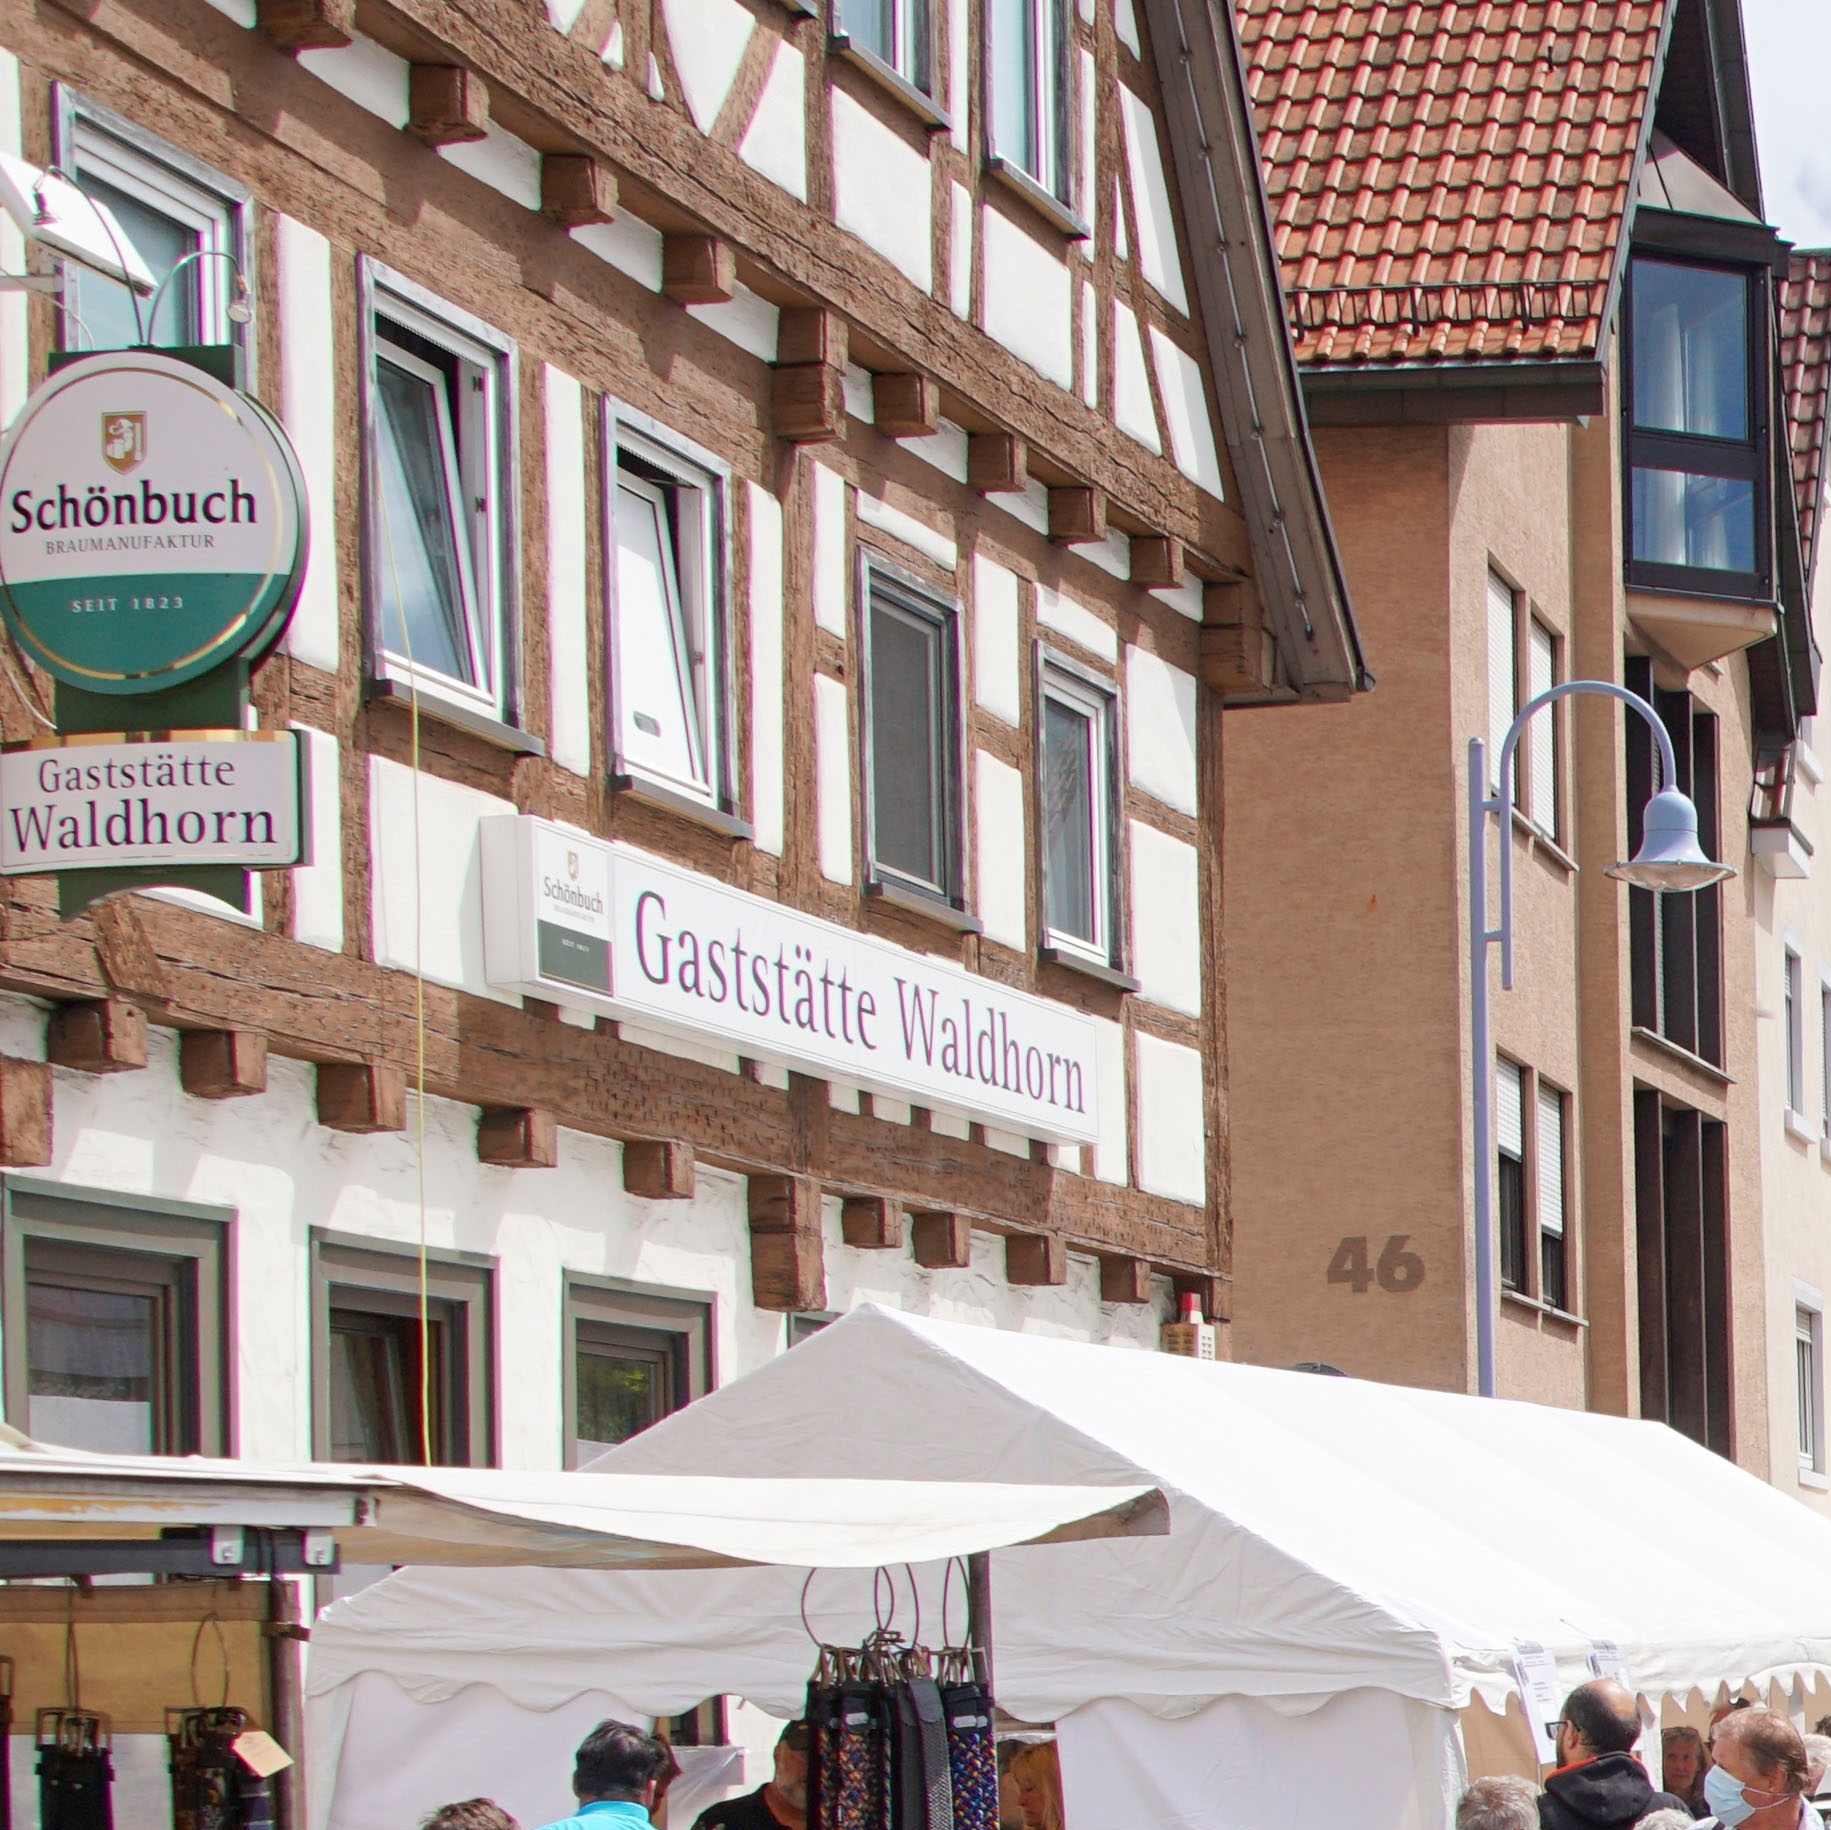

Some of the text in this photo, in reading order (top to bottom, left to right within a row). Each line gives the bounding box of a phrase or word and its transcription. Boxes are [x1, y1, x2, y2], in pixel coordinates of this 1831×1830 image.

[11, 478, 259, 534] Schönbuch
[45, 535, 216, 556] BRAUMANUFAKTUR
[71, 596, 185, 613] SEIT 1823
[38, 754, 236, 793] Gaststätte
[9, 798, 278, 852] Waldhorn
[543, 875, 604, 914] Schönbuch
[636, 890, 1087, 1113] Gaststätte Waldhorn
[1326, 1233, 1426, 1293] 46
